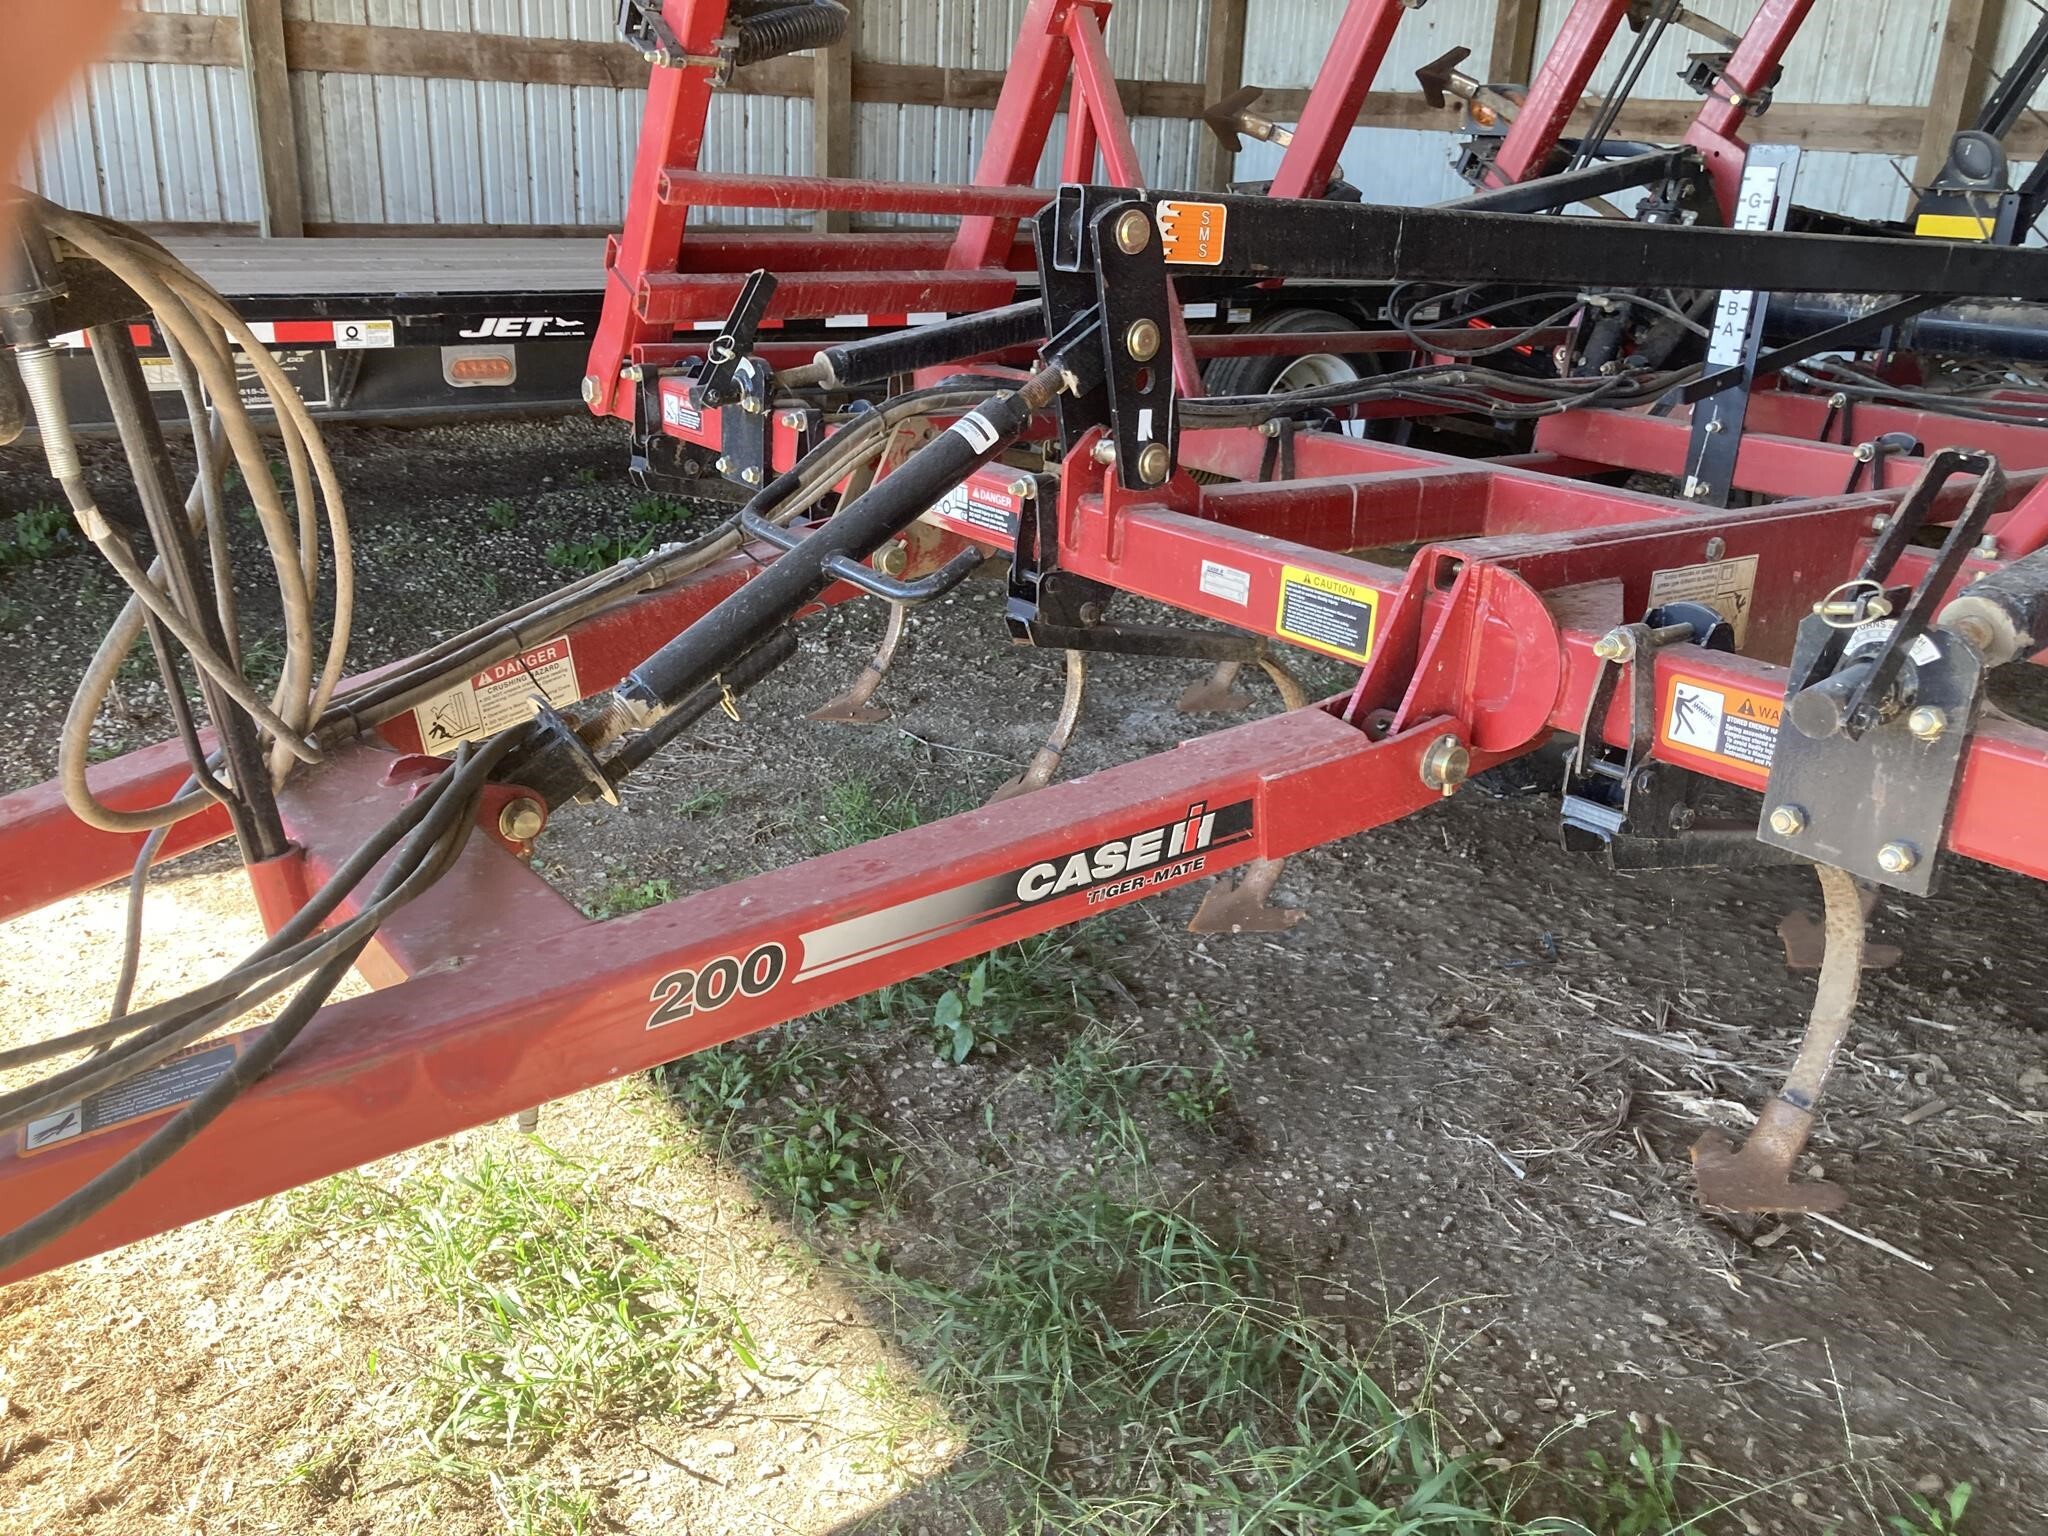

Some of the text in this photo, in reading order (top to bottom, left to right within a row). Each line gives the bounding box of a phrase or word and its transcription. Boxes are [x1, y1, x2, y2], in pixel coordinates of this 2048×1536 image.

[1748, 192, 1761, 209] G
[1726, 301, 1738, 316] B
[459, 317, 553, 338] JET
[1722, 322, 1734, 337] A
[980, 489, 1012, 508] DANGER
[1314, 577, 1355, 596] CAUTION
[495, 647, 557, 678] DANGER
[487, 674, 527, 694] CRUSHING
[1726, 715, 1748, 727] STORED
[1748, 721, 1770, 733] ENERGY
[1017, 828, 1165, 902] CASE
[646, 942, 787, 1031] 200
